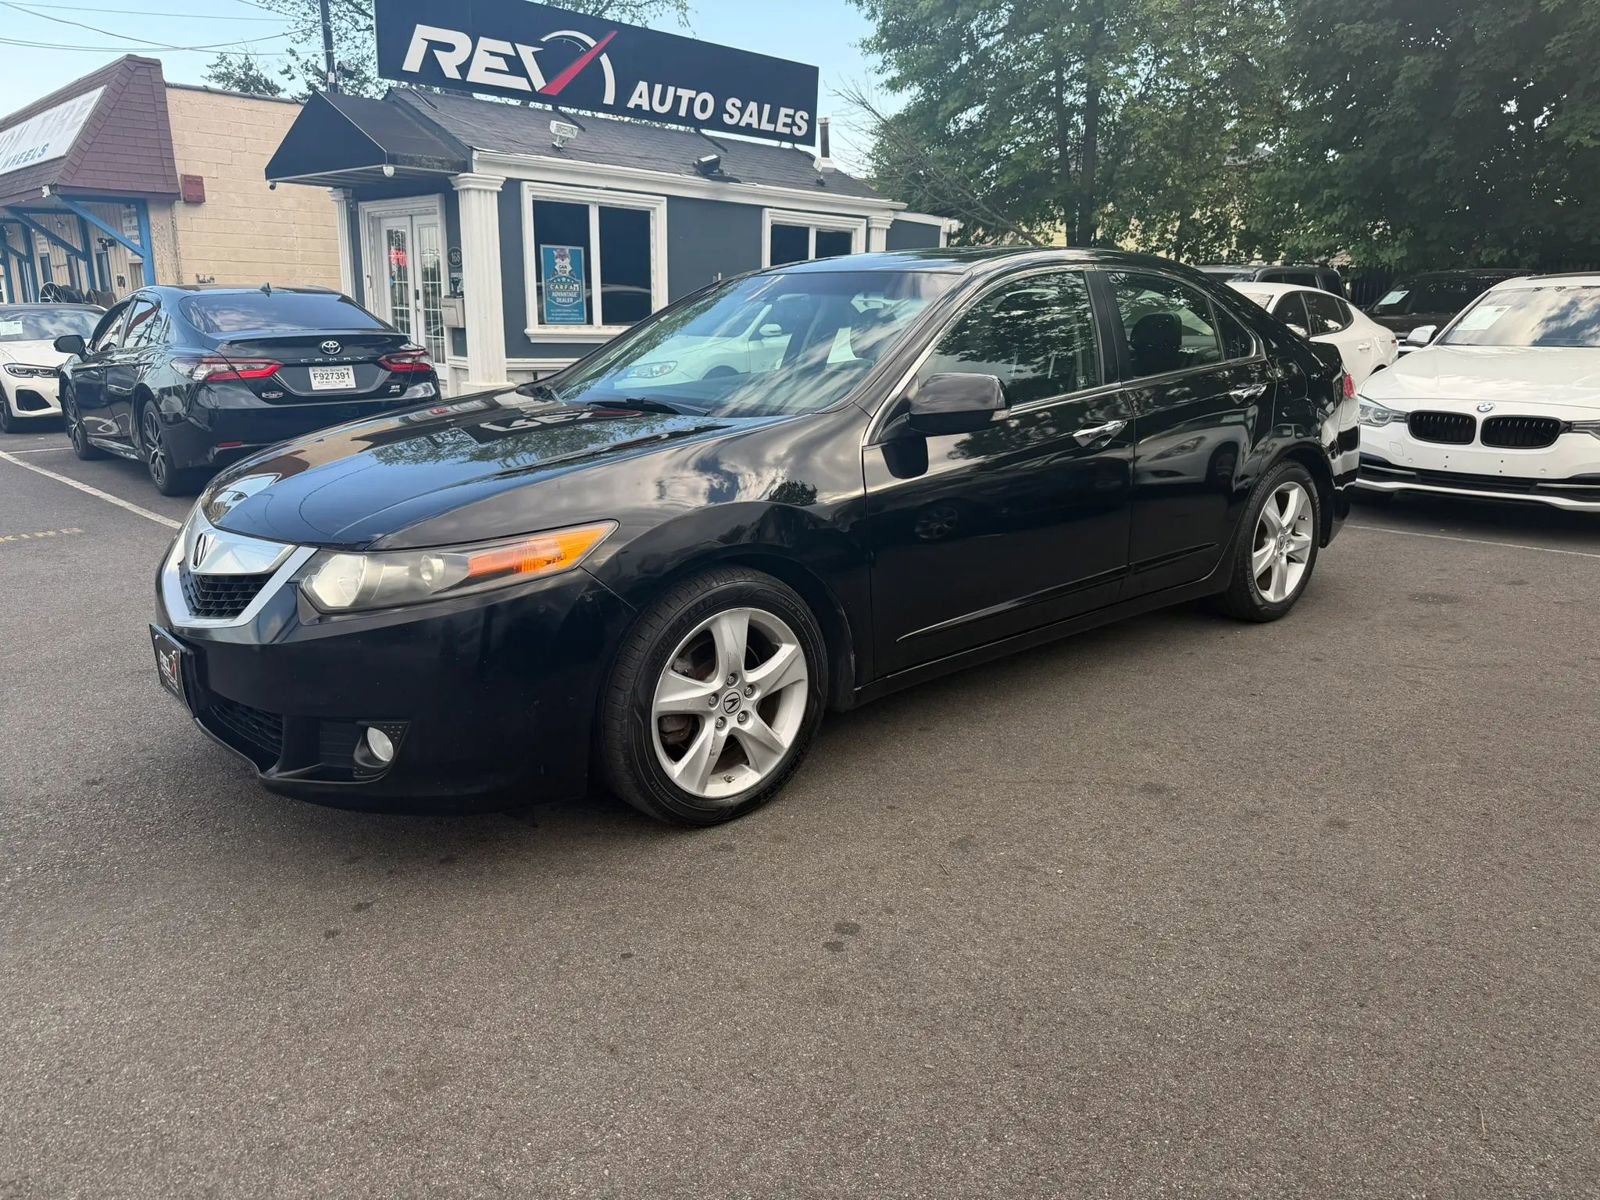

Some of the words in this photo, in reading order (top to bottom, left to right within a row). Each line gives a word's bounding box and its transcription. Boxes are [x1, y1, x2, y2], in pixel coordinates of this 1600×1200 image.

[627, 81, 715, 120] AUTO
[722, 97, 809, 137] SALES
[313, 372, 350, 381] F927391
